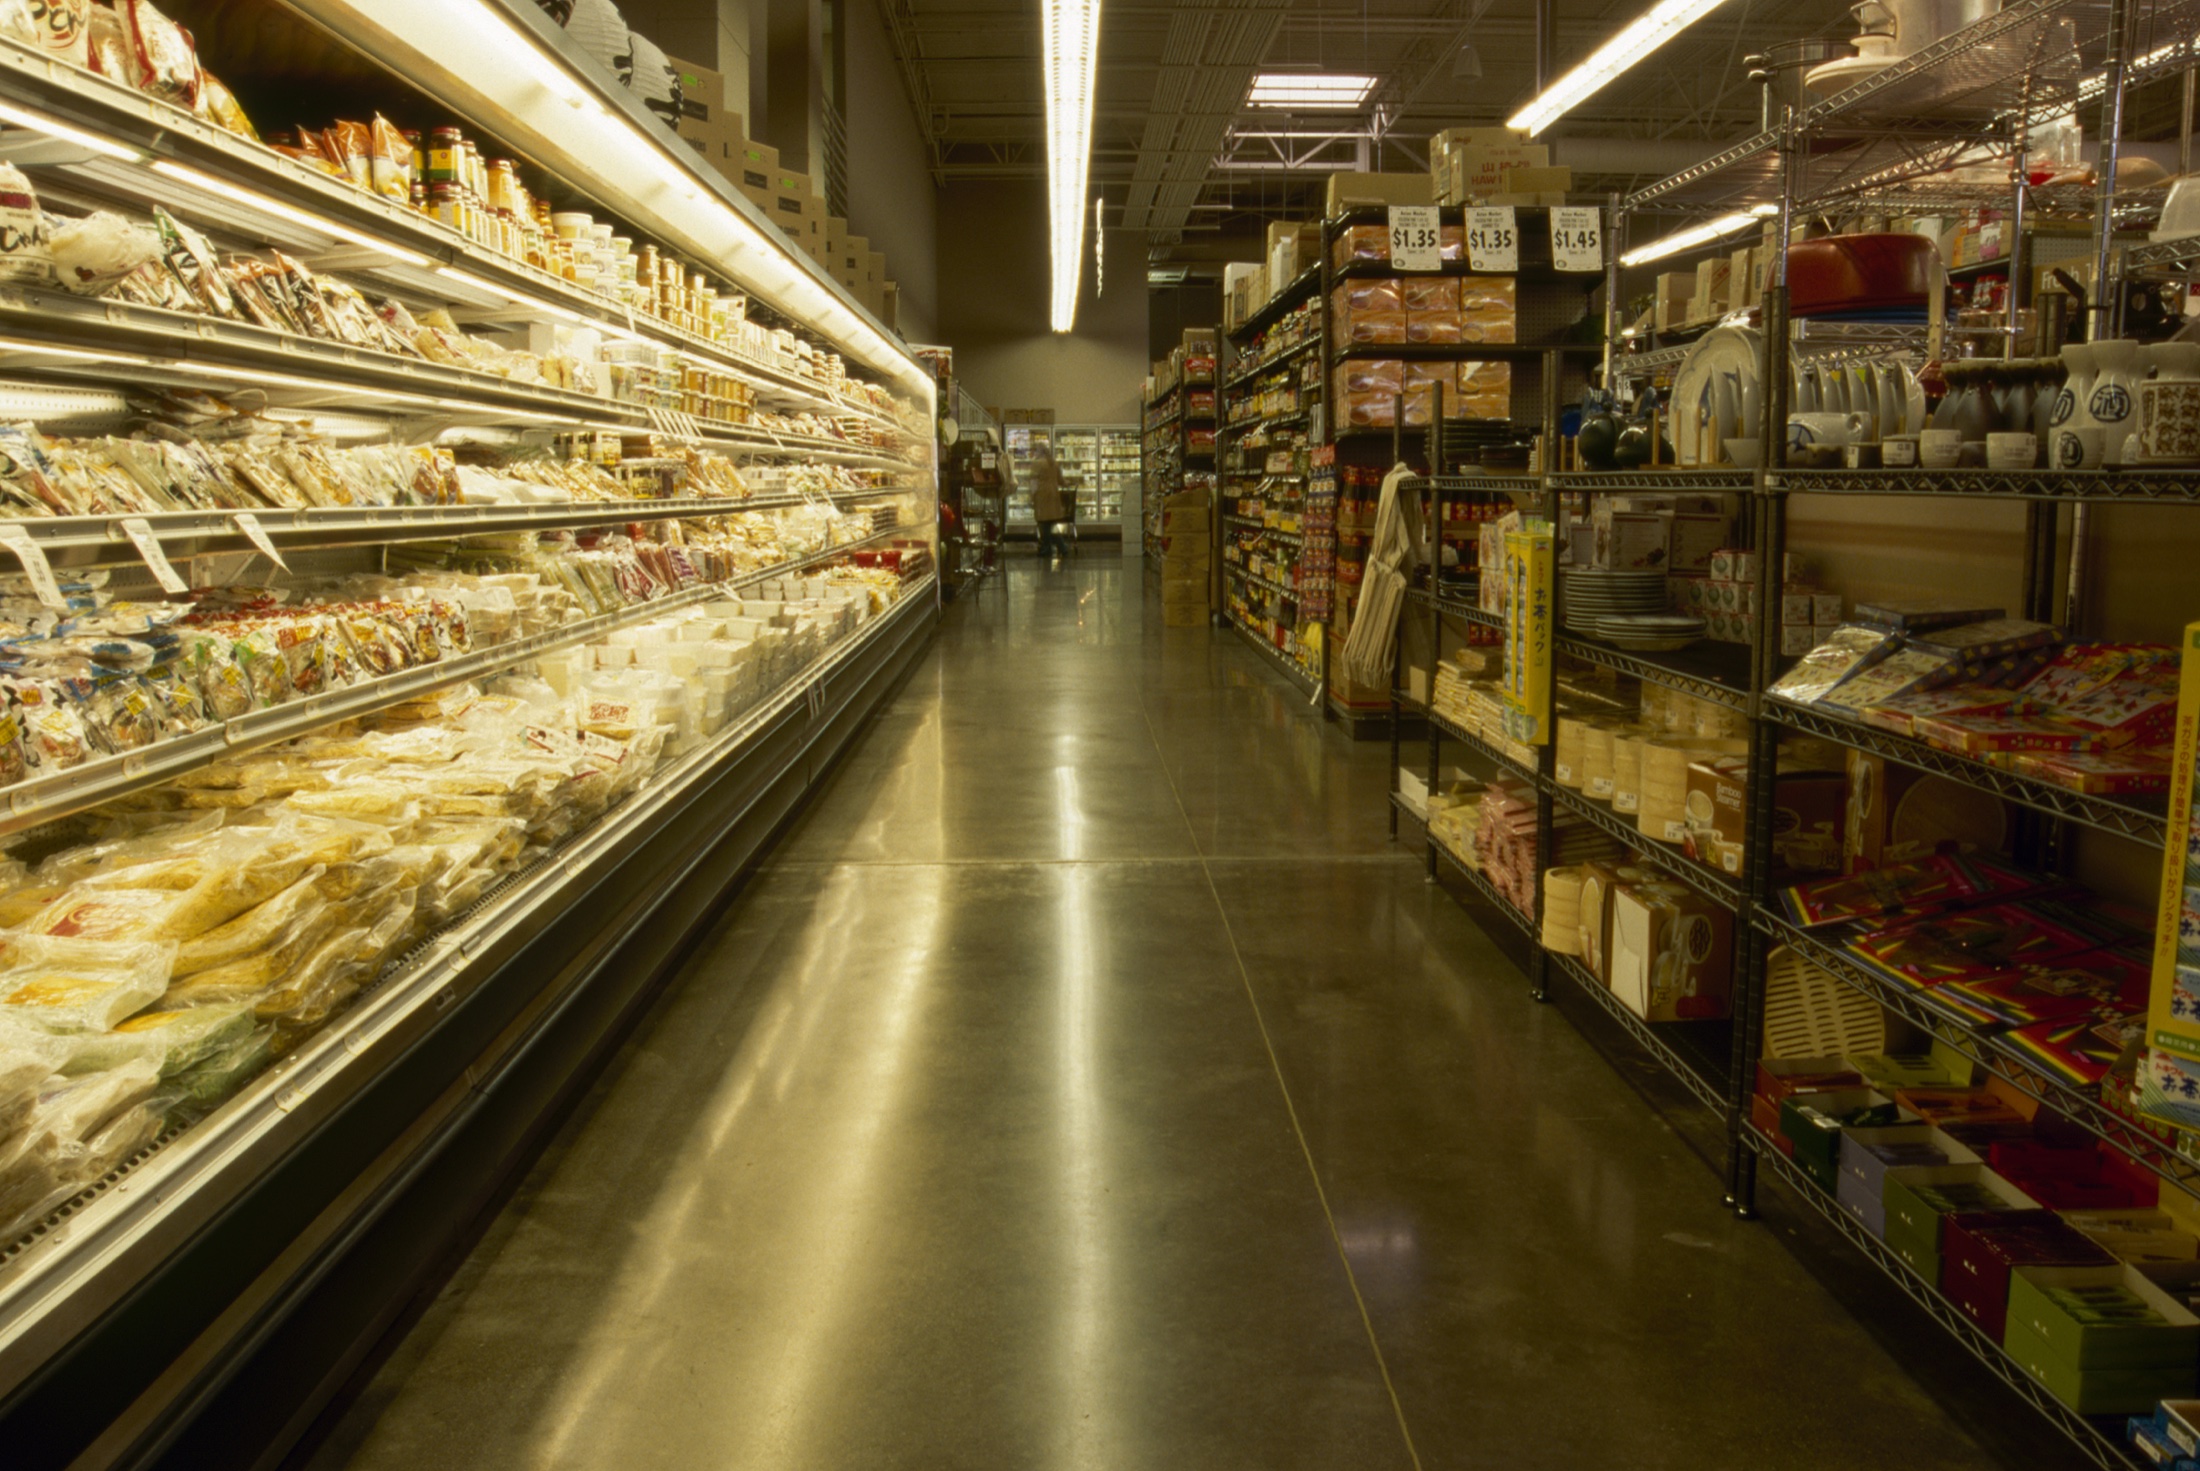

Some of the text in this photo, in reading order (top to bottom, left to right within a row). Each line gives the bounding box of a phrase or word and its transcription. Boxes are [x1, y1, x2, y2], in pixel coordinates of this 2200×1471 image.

[1393, 228, 1437, 249] $1.35
[1470, 229, 1512, 250] $1.35
[1555, 229, 1597, 249] $1.45
[2041, 266, 2080, 290] Freh
[1533, 588, 1548, 653] お茶パック
[1716, 782, 1742, 799] Bamboo
[2161, 1074, 2200, 1100] お茶
